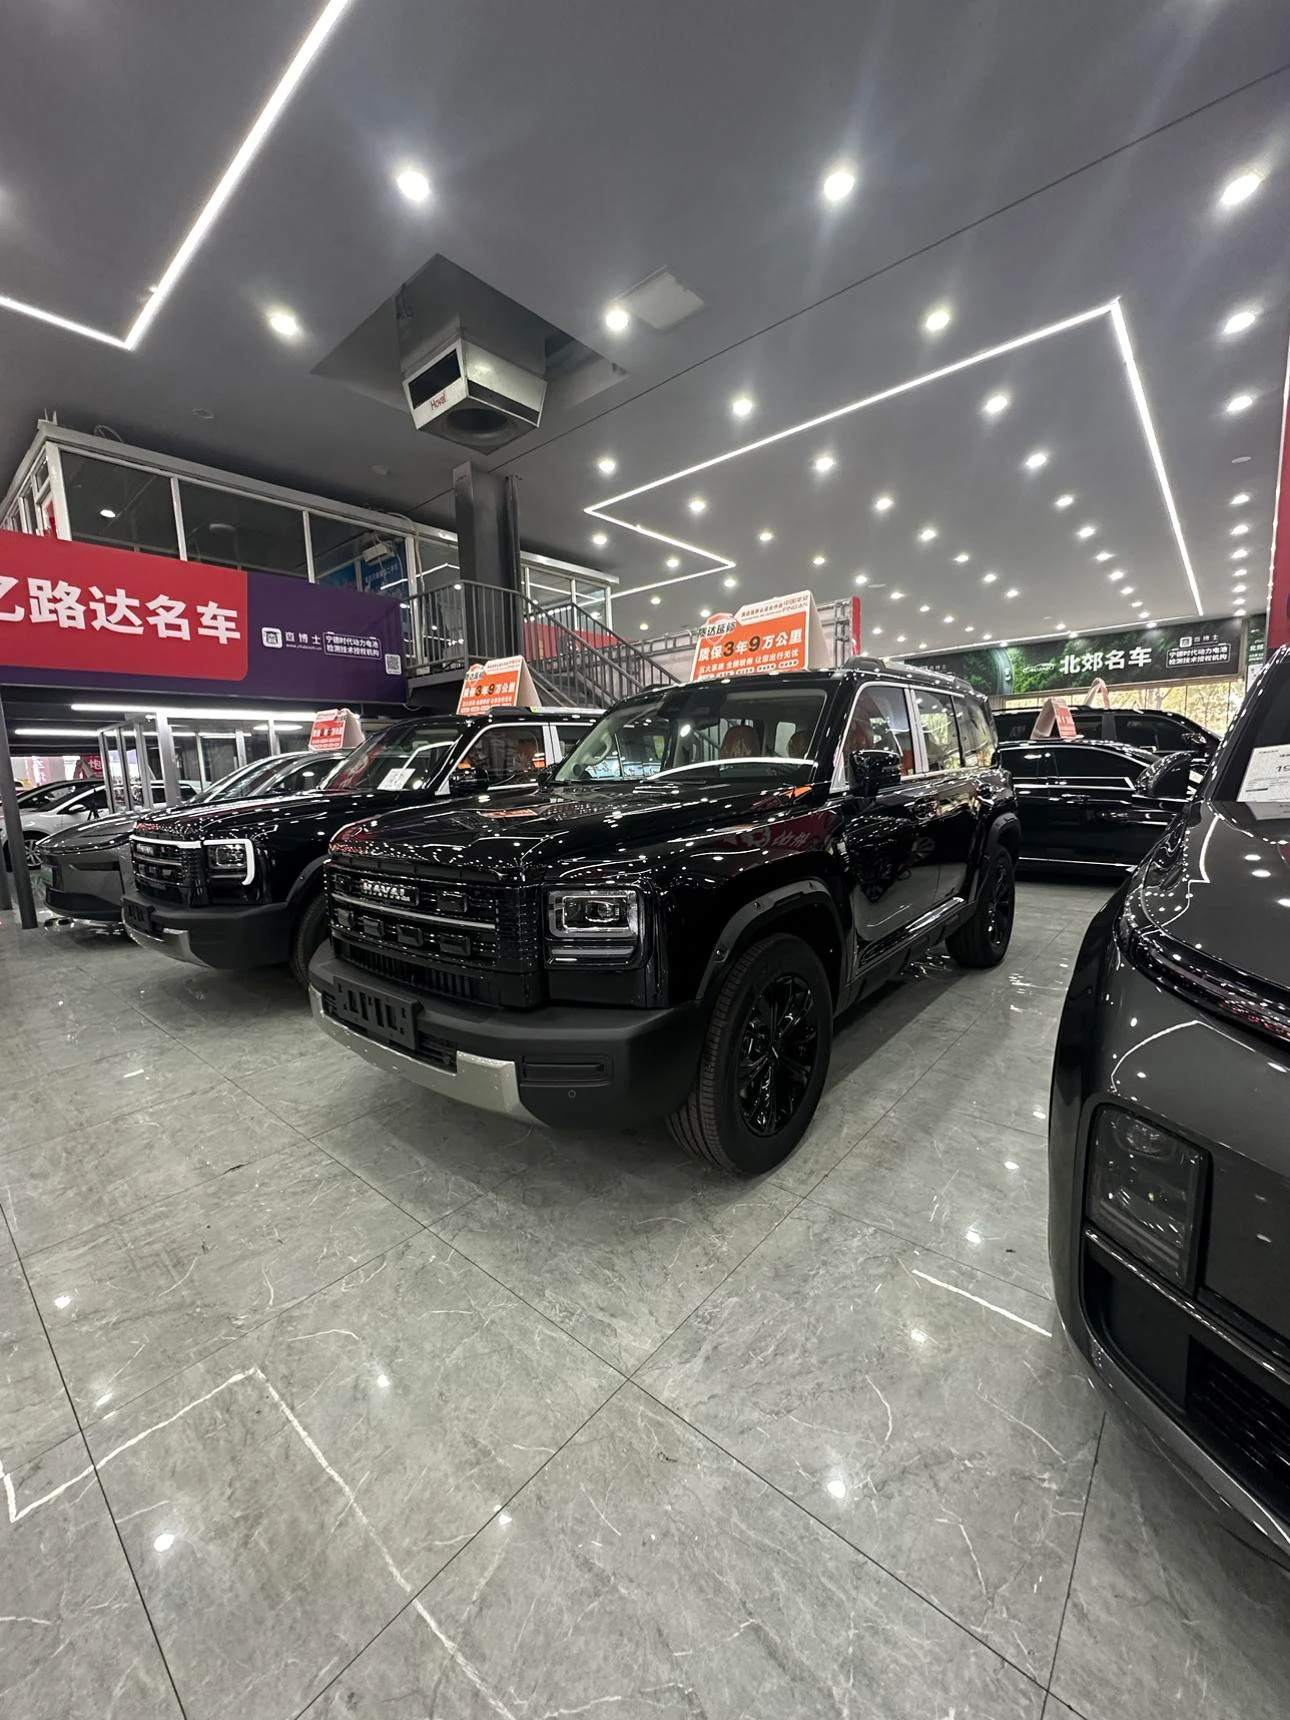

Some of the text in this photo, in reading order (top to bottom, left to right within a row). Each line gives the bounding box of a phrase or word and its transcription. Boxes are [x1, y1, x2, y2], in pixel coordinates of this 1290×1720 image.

[430, 392, 449, 410] Hoval
[698, 628, 802, 662] 质保3年9万公里
[1169, 646, 1228, 658] 宁德时代动力电池
[1059, 646, 1152, 674] 北郊名车
[362, 882, 410, 902] HAVAL
